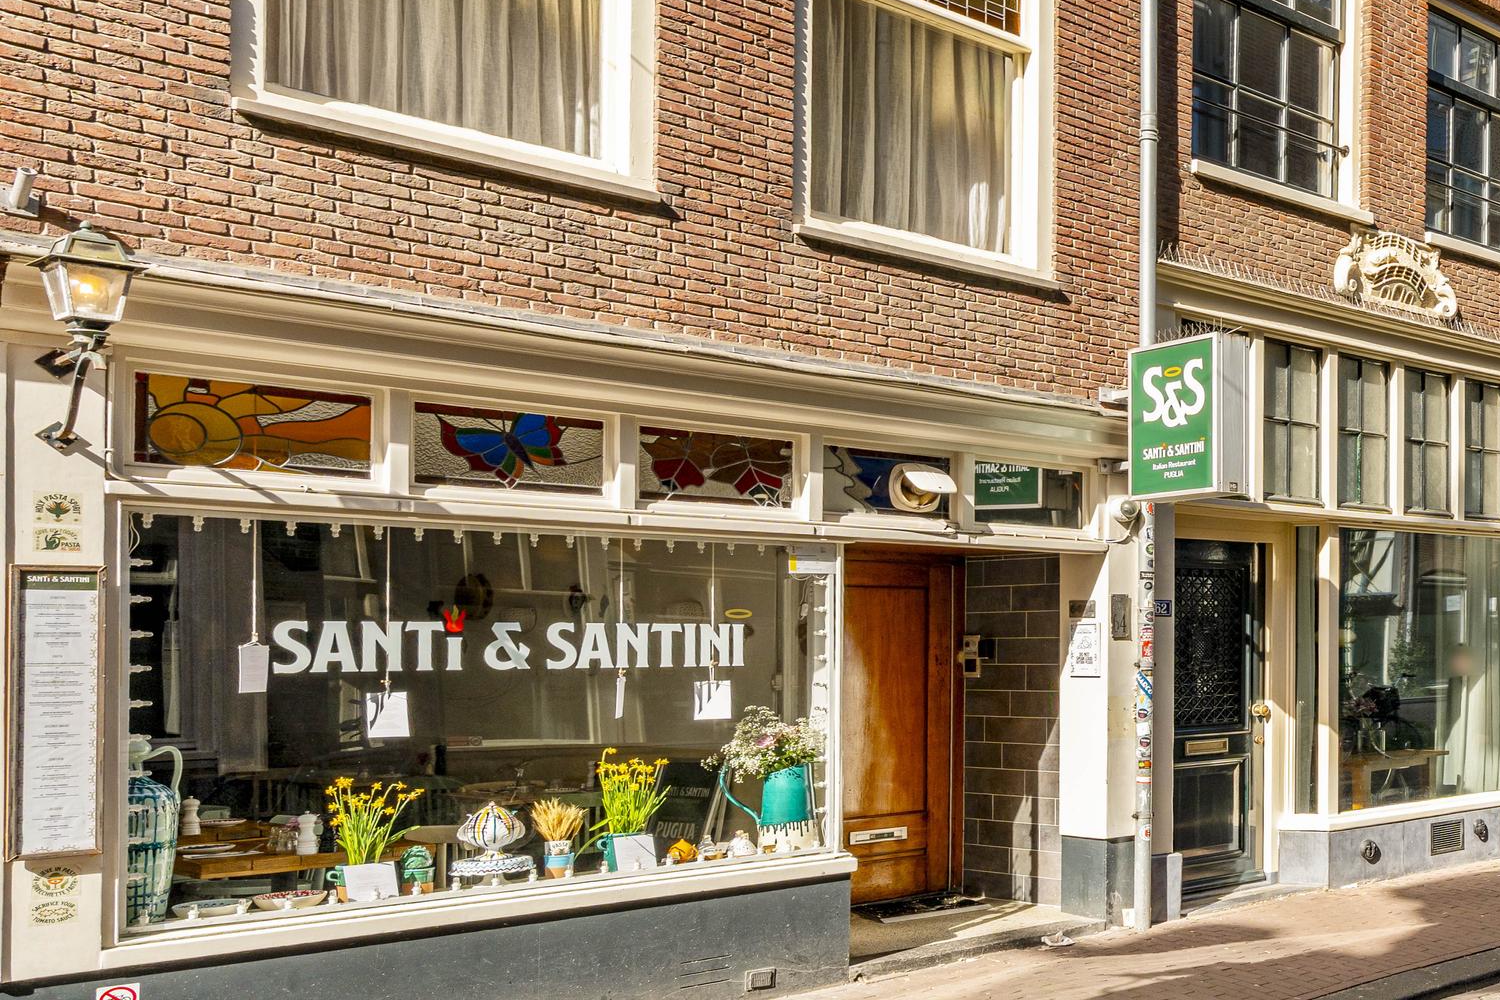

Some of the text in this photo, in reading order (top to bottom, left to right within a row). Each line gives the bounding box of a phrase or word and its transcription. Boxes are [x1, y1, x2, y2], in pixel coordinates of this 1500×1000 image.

[1142, 358, 1206, 427] S&S
[1167, 447, 1173, 457] &
[1174, 439, 1205, 456] SANTINI
[1152, 458, 1197, 471] Italian Restaurant
[1163, 470, 1184, 479] PUGLIA
[44, 493, 68, 501] PASTA
[68, 498, 81, 515] SPIRIT
[1155, 603, 1168, 614] 62
[484, 622, 531, 670] &
[546, 622, 745, 670] SANTINI
[655, 821, 696, 840] PUGLIA
[32, 901, 59, 912] SACRIFICE
[33, 913, 75, 924] TOMATO SAUCE
